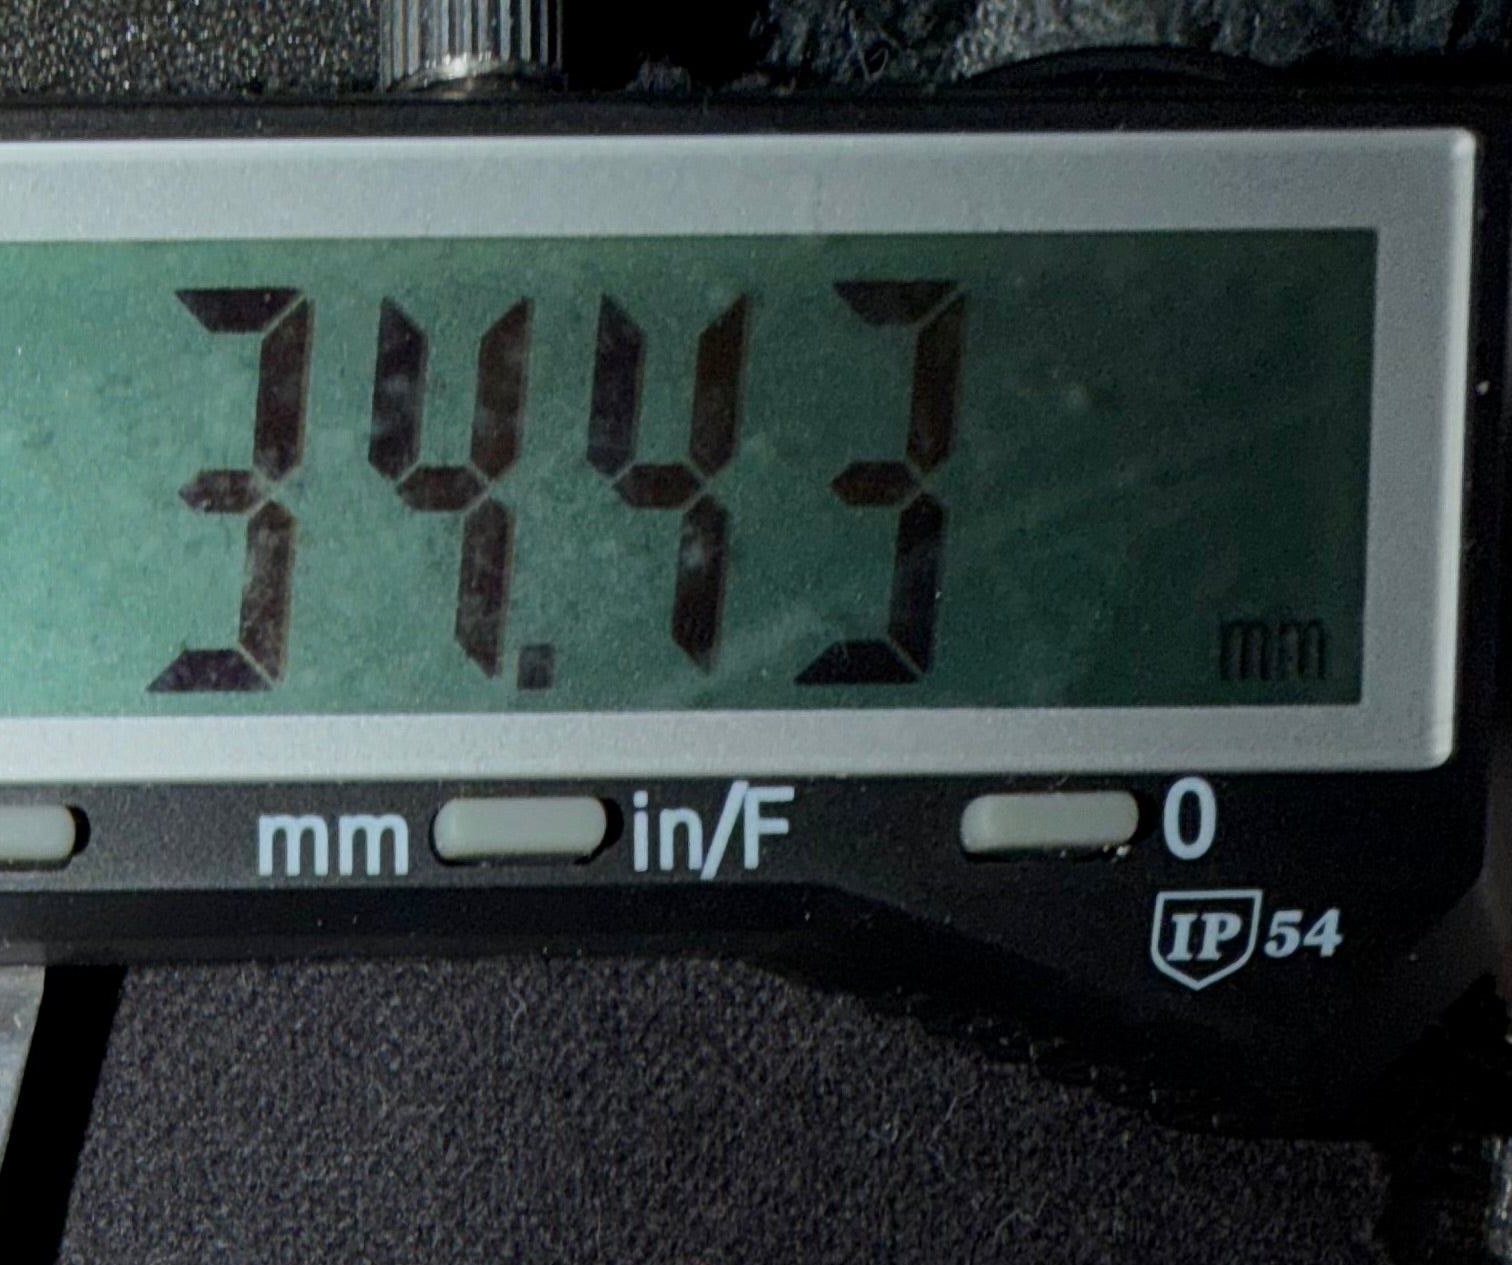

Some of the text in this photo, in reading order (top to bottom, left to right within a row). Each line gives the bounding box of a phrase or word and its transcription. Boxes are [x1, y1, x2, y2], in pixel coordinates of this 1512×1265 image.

[148, 281, 1329, 693] 34.43 mm
[255, 812, 410, 876] mm
[631, 779, 795, 880] in/F
